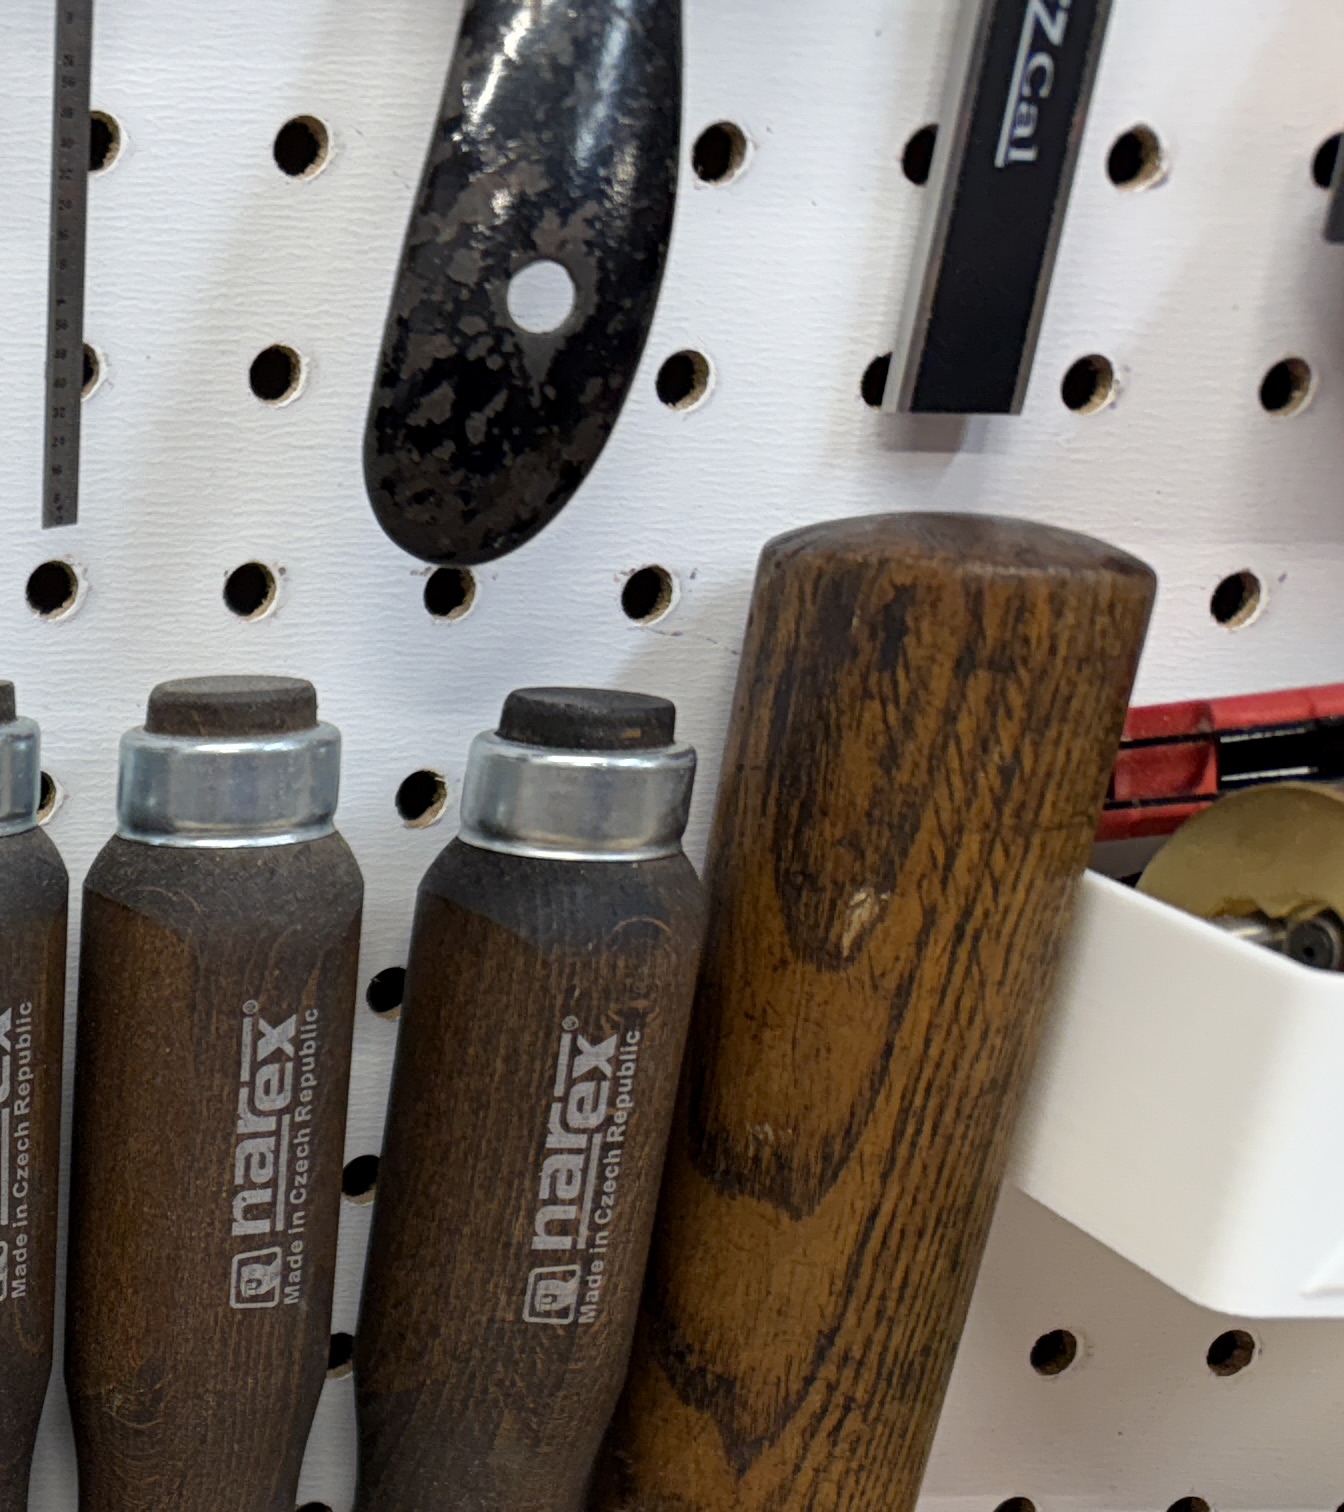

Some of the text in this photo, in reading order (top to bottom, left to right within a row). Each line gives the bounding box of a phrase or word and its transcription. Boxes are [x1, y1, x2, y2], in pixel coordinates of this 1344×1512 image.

[1000, 0, 1072, 164] ZCal
[12, 1002, 33, 1299] Made in Czech Republic
[283, 1009, 319, 1305] Made in Czech Republic
[578, 1029, 641, 1324] Made in Czech Republic
